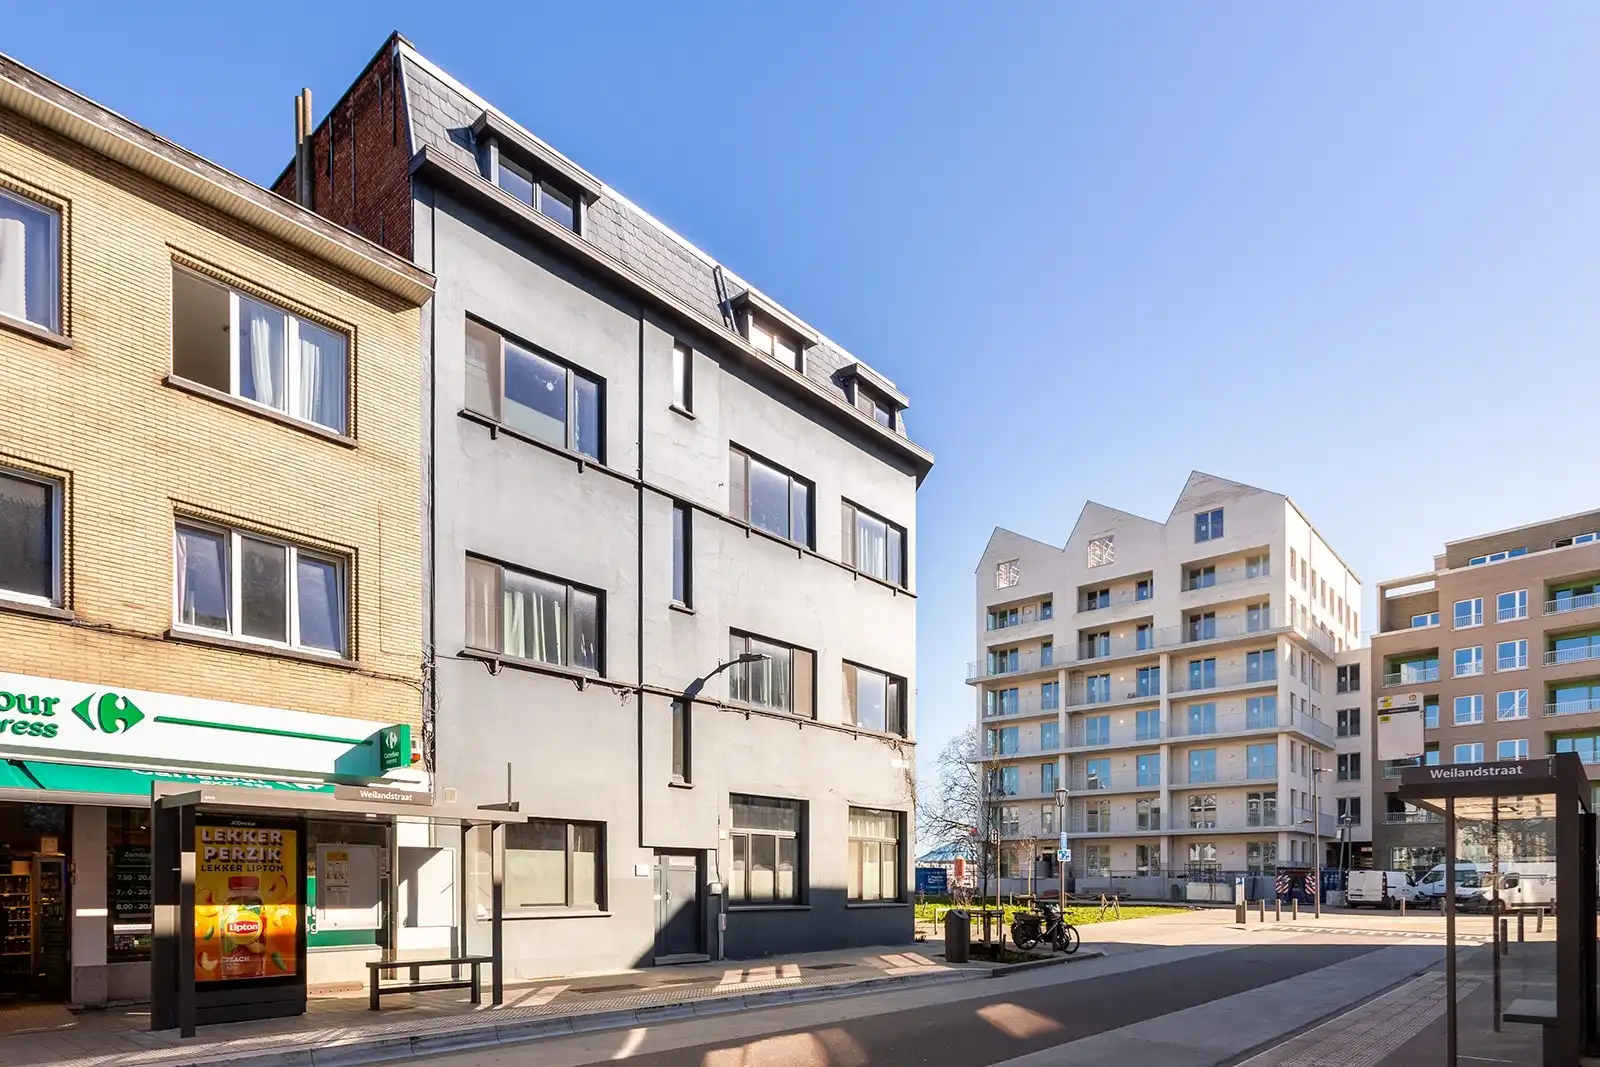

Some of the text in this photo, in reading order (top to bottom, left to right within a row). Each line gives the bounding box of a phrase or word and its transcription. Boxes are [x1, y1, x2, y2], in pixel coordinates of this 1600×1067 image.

[0, 691, 60, 716] our
[1430, 765, 1523, 779] Weilandstraat
[360, 789, 413, 801] Weilandstraat
[201, 828, 283, 846] LEKKER
[204, 846, 281, 863] PERZIK
[201, 864, 283, 872] LEKKER LIPTON
[229, 922, 258, 933] Lipton
